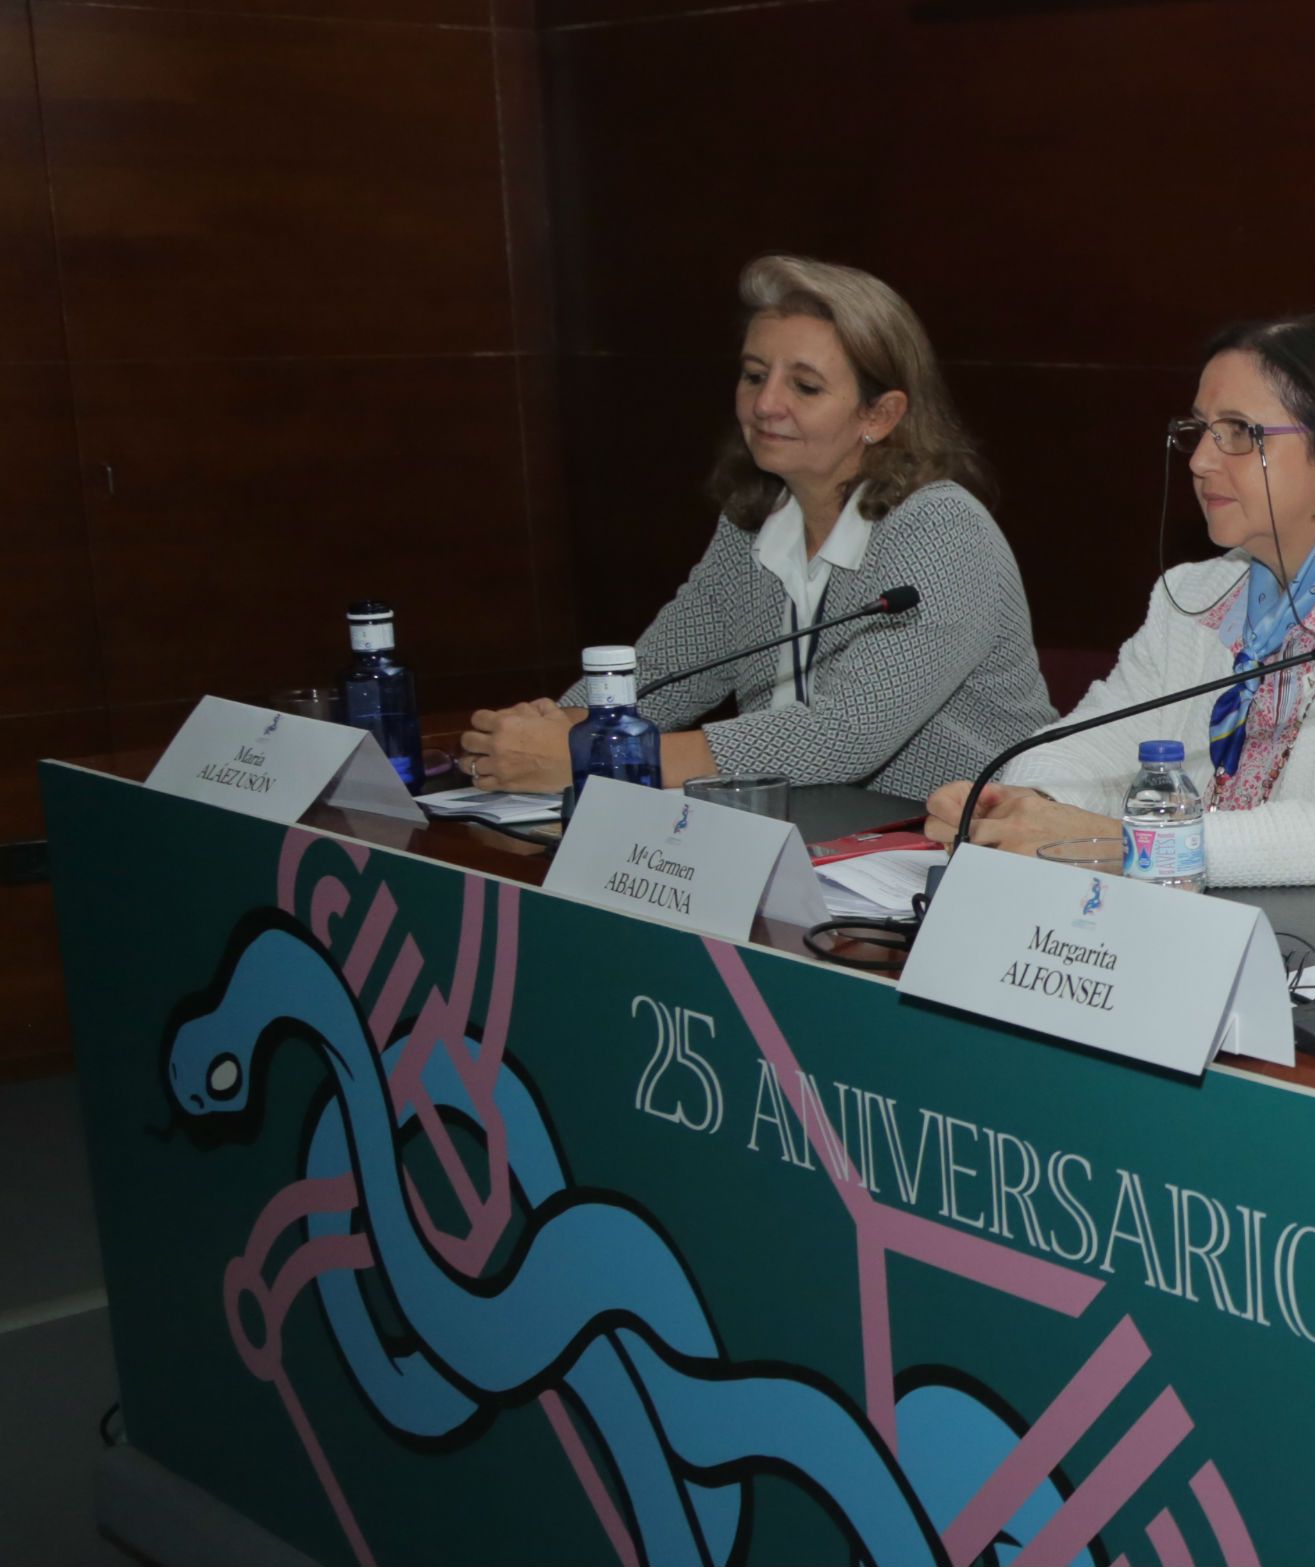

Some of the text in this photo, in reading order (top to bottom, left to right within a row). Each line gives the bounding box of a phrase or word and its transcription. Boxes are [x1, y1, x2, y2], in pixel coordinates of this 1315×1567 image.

[647, 849, 695, 881] Carmen
[604, 871, 691, 915] ABAD LUNA
[1027, 925, 1118, 971] Margarita
[1000, 960, 1115, 1011] ALFONSEL
[631, 995, 723, 1135] 25
